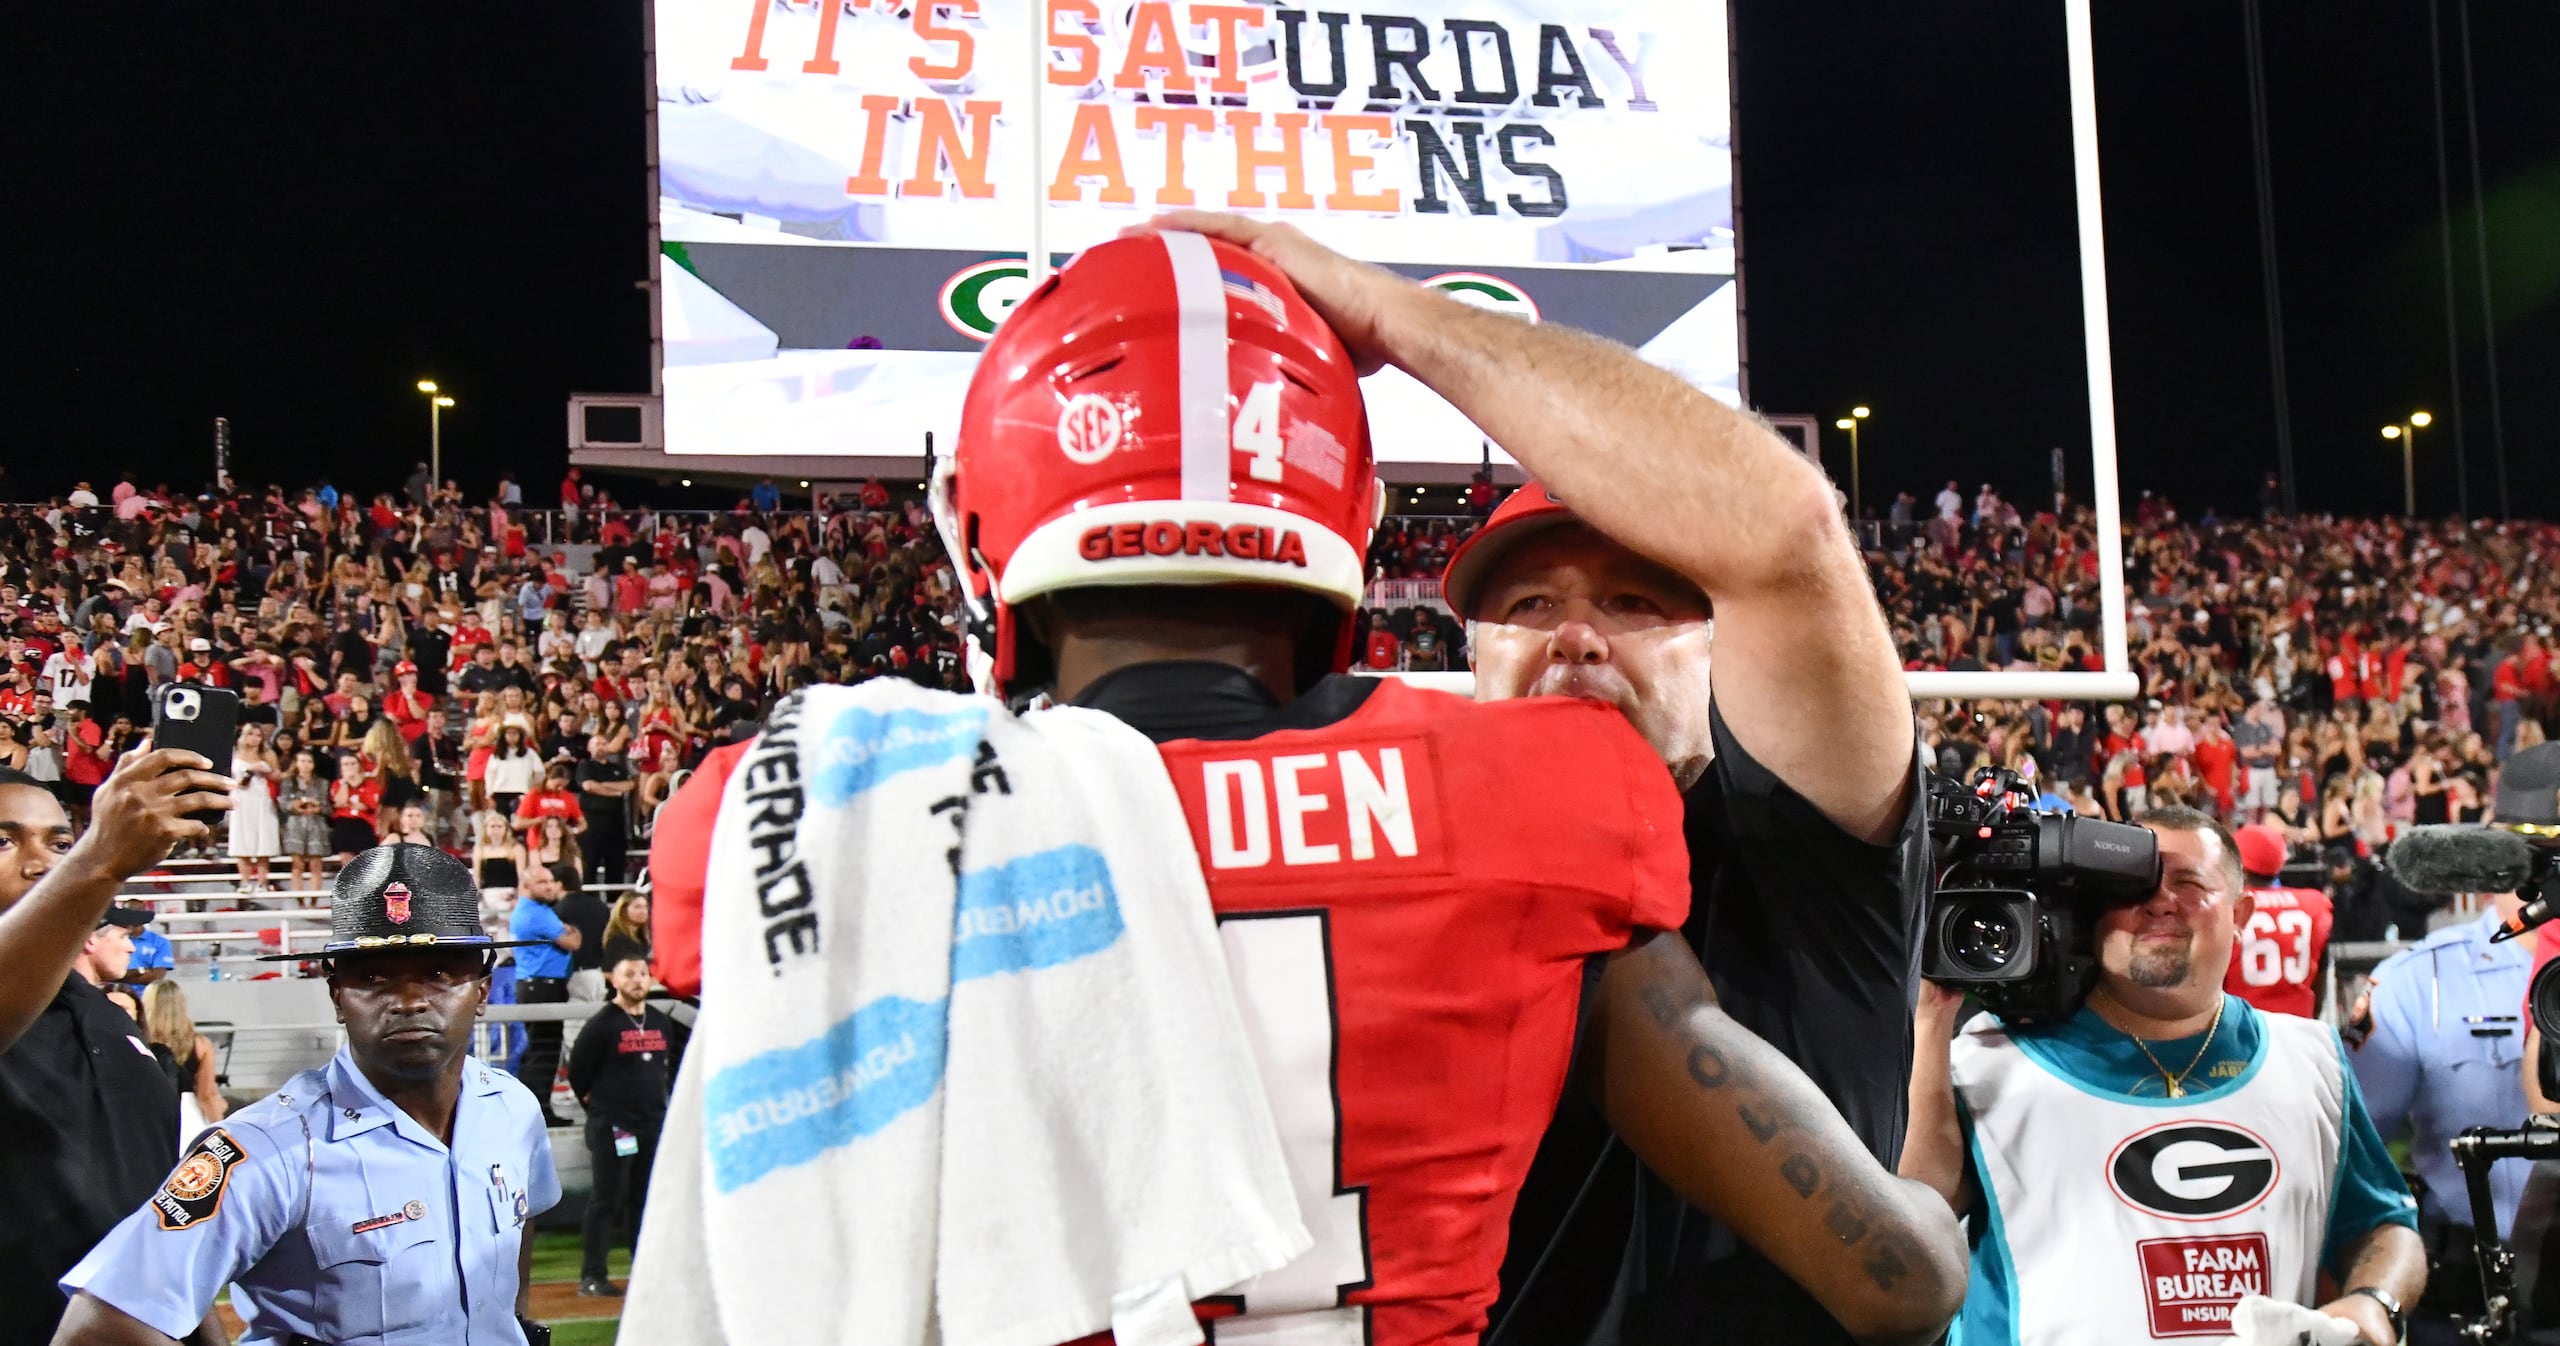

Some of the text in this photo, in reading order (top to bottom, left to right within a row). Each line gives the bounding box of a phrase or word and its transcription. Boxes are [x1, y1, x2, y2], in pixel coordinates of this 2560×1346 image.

[1047, 0, 1661, 112] SATURDAY
[846, 95, 1570, 218] IN ATHENS
[1067, 404, 1111, 453] SEC
[1233, 380, 1285, 483] 4
[1079, 520, 1308, 568] GEORGIA
[1202, 747, 1418, 870] DEN
[2240, 909, 2313, 987] 63
[2113, 1126, 2273, 1215] G
[2155, 1271, 2262, 1301] BUREAU
[2182, 1247, 2260, 1273] FARM
